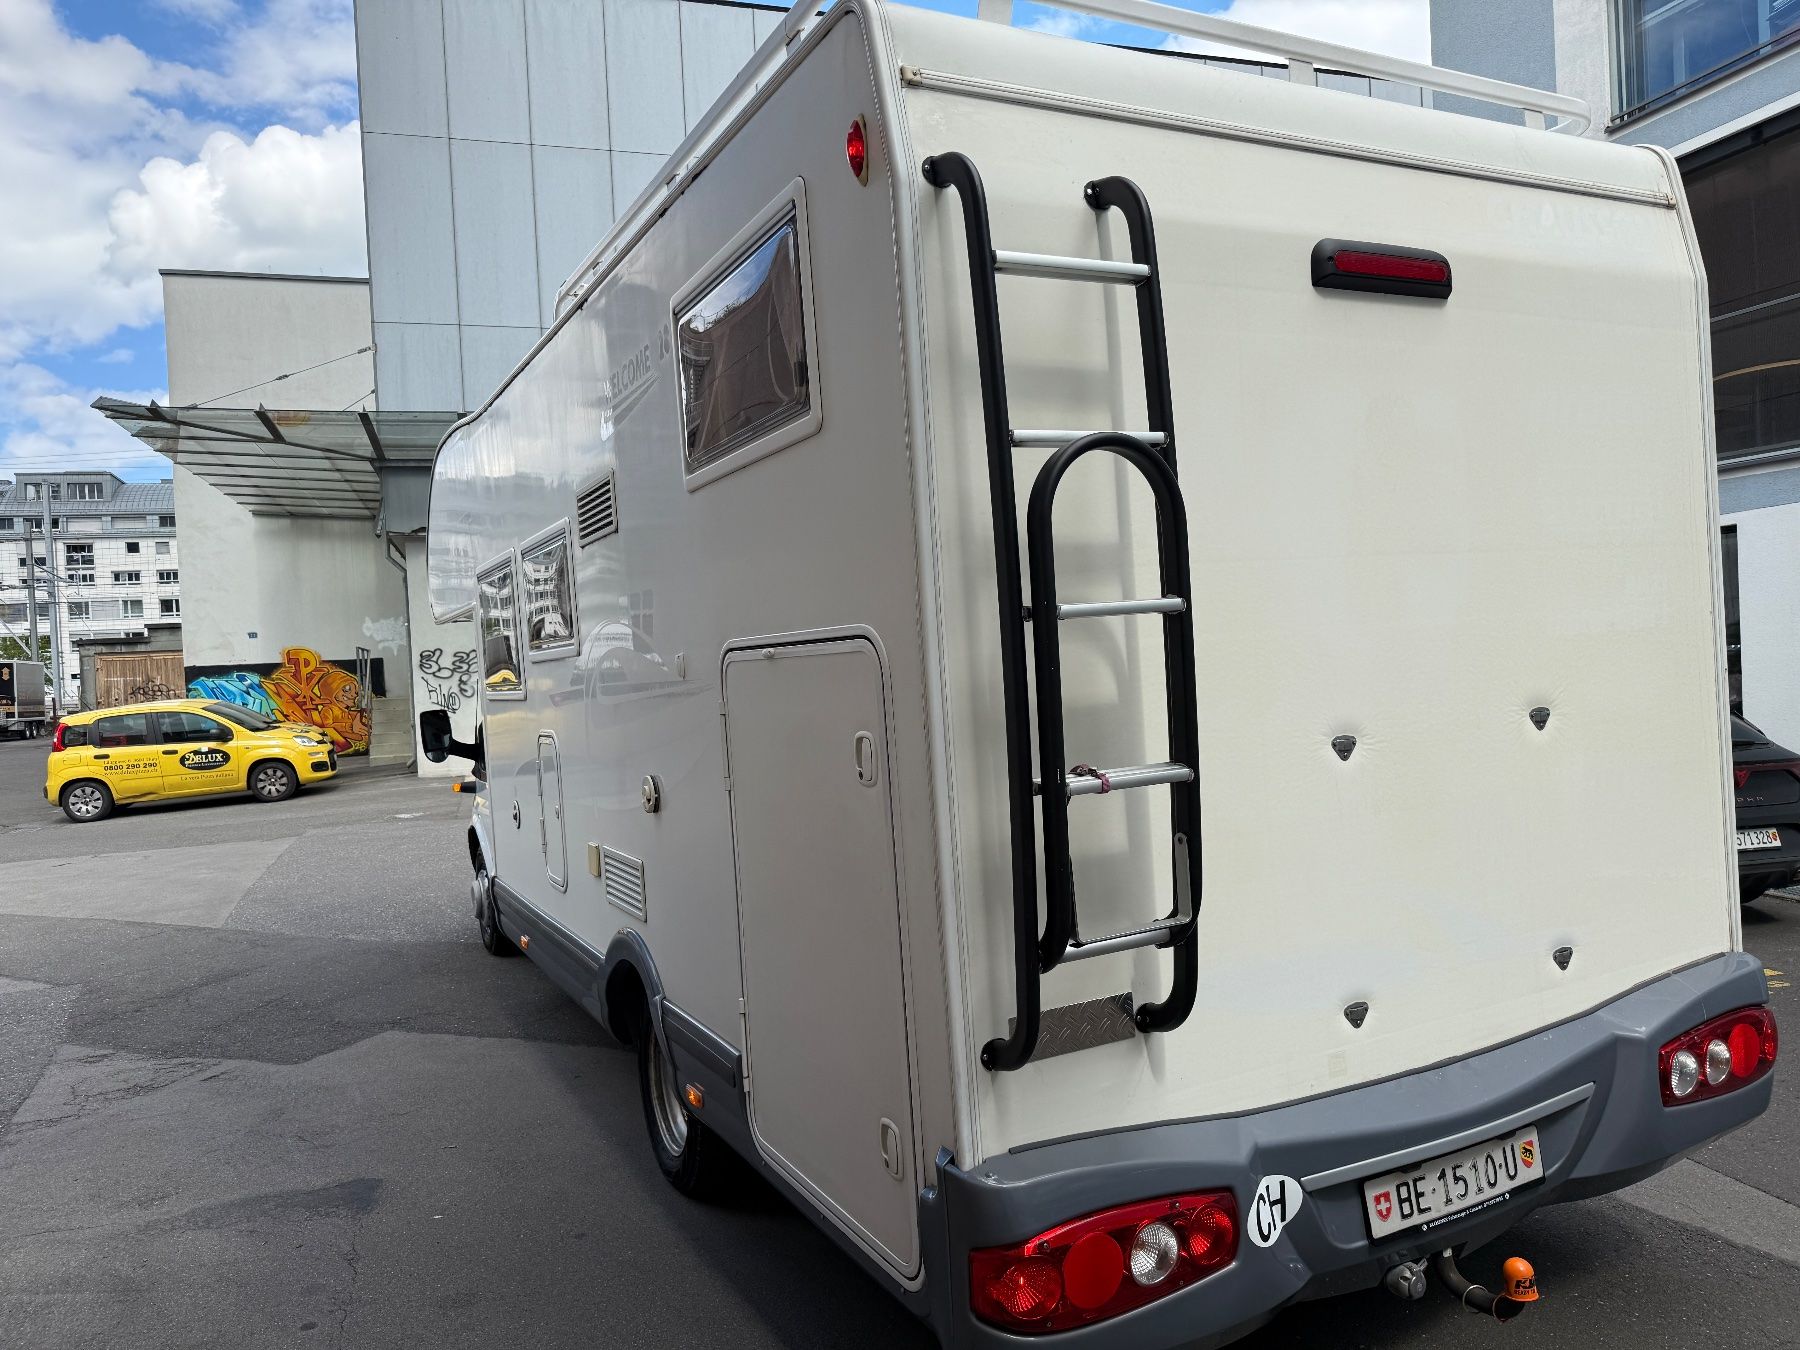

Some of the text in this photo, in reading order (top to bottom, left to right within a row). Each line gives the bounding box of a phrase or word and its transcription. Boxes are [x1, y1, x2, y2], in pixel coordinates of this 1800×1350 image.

[604, 344, 650, 404] WELCOME
[185, 753, 224, 764] DELUX
[1257, 1180, 1286, 1243] CH
